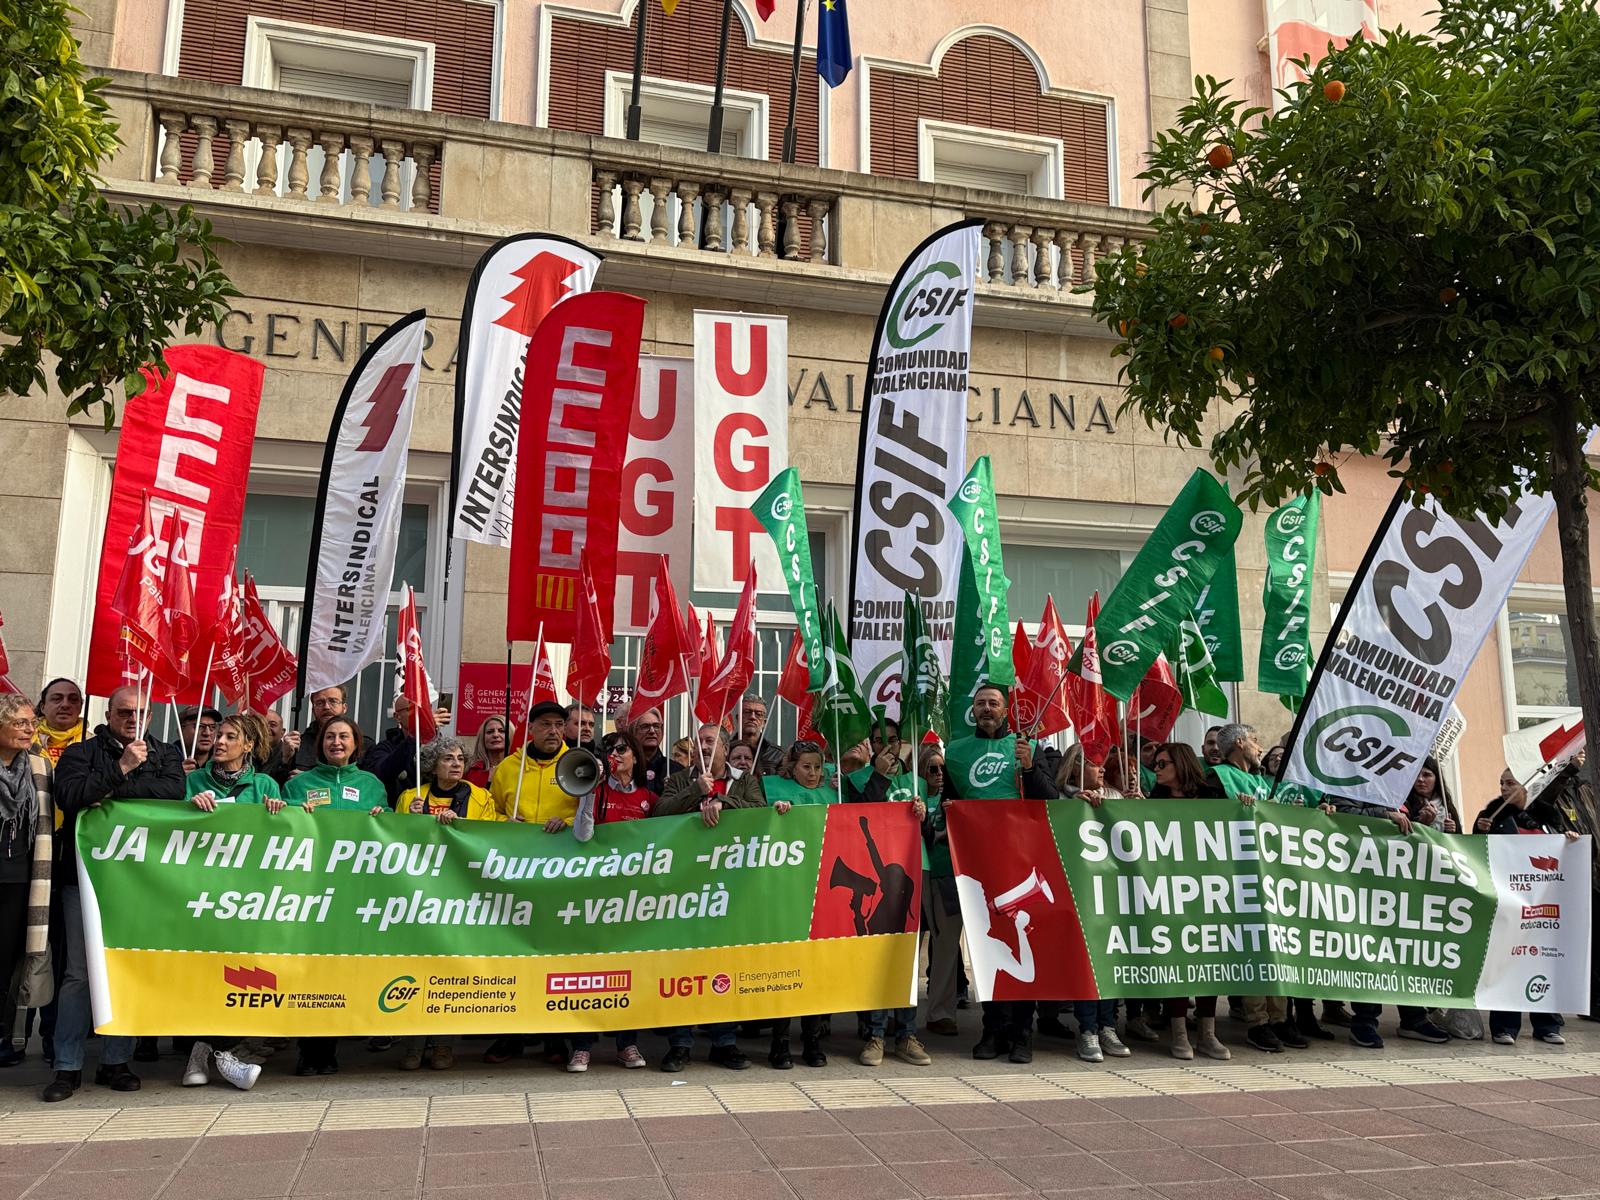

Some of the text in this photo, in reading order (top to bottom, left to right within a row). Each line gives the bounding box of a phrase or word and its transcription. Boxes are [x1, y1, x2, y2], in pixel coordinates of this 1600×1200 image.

[903, 287, 968, 322] CSIF
[875, 350, 967, 375] COMUNIDAD
[871, 371, 967, 395] VALENCIANA
[459, 343, 531, 534] INTERSINDIC
[538, 325, 613, 570] CCOO
[713, 321, 770, 582] UGT
[617, 367, 677, 627] UGT
[864, 397, 947, 598] CSIF
[1197, 513, 1226, 534] CSIF
[1282, 514, 1306, 526] CSIF
[328, 475, 379, 653] INTERSINDICAL
[973, 507, 1001, 625] CSIF
[785, 523, 812, 638] CSIF
[1118, 540, 1206, 635] CSIF
[1277, 535, 1308, 641] CSIF
[1372, 493, 1524, 666] CSI
[352, 563, 376, 654] VALENCIANA
[853, 599, 955, 620] COMUDAD
[852, 621, 954, 642] VALENNA
[1112, 645, 1140, 663] CSIF
[1280, 649, 1308, 664] CSIF
[1334, 627, 1457, 699] COMUNIDAD
[477, 689, 527, 698] GENERLITA
[1324, 651, 1444, 722] VALENCIANA
[477, 697, 522, 705] VALENCAN
[1323, 725, 1419, 776] CSIF
[976, 761, 1010, 776] CSIF
[91, 824, 149, 862] JA
[259, 836, 316, 873] HA
[325, 840, 445, 876] PROU!
[467, 842, 675, 881] -burocràcia
[696, 835, 806, 871] -ràtios
[1078, 818, 1481, 889] SOM NECESSÀRIES
[1509, 883, 1532, 892] STAS
[186, 881, 731, 933] +salari +plantilla +valencià
[1093, 873, 1474, 935] I IMPRESCINDIBLES
[1520, 919, 1560, 930] educació
[1106, 922, 1461, 970] ALS CENTRES EDUCATIUS
[1511, 945, 1527, 956] UGT
[386, 986, 421, 1000] CSIF
[429, 975, 517, 986] Central Sindical
[550, 974, 606, 991] CCOO
[657, 968, 802, 999] UGT Ensenyament
[738, 984, 765, 995] Serveis
[792, 980, 804, 992] PV
[1113, 965, 1184, 984] PERSONAL
[1301, 966, 1305, 984] I
[1401, 975, 1405, 993] I
[1407, 976, 1454, 997] SERVEIS
[1530, 983, 1551, 995] CSIF
[225, 992, 347, 1009] STEPV INTERSINDICAL
[297, 1001, 346, 1009] VALENCIANA
[427, 989, 517, 1002] Independiente y
[545, 992, 631, 1012] educació
[426, 1003, 517, 1014] de Funcionarios
